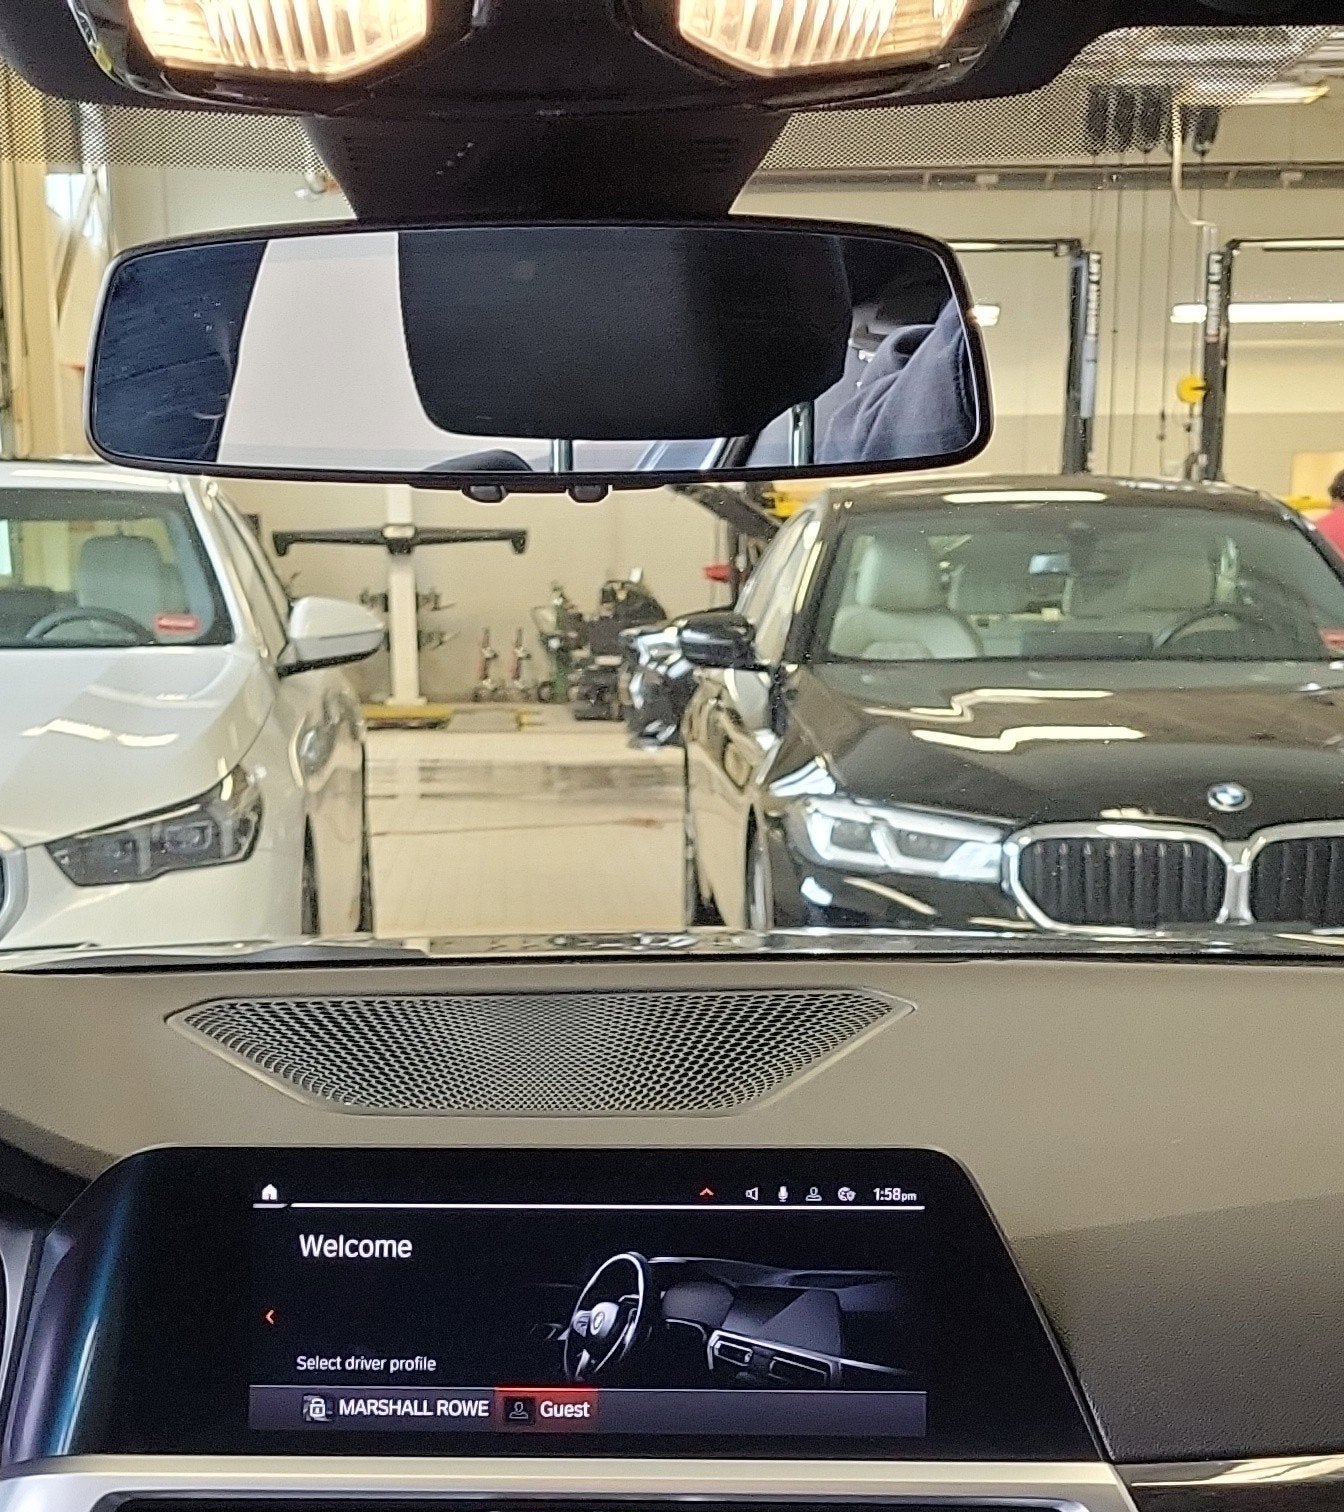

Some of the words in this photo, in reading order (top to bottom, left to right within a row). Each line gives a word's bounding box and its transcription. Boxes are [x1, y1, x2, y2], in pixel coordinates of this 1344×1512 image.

[299, 1234, 413, 1258] Welcome
[296, 1356, 342, 1371] Select
[344, 1356, 387, 1371] driver
[389, 1355, 437, 1373] profile
[338, 1399, 434, 1417] MARSHALL
[436, 1400, 490, 1417] ROWE
[540, 1400, 590, 1418] Guest
